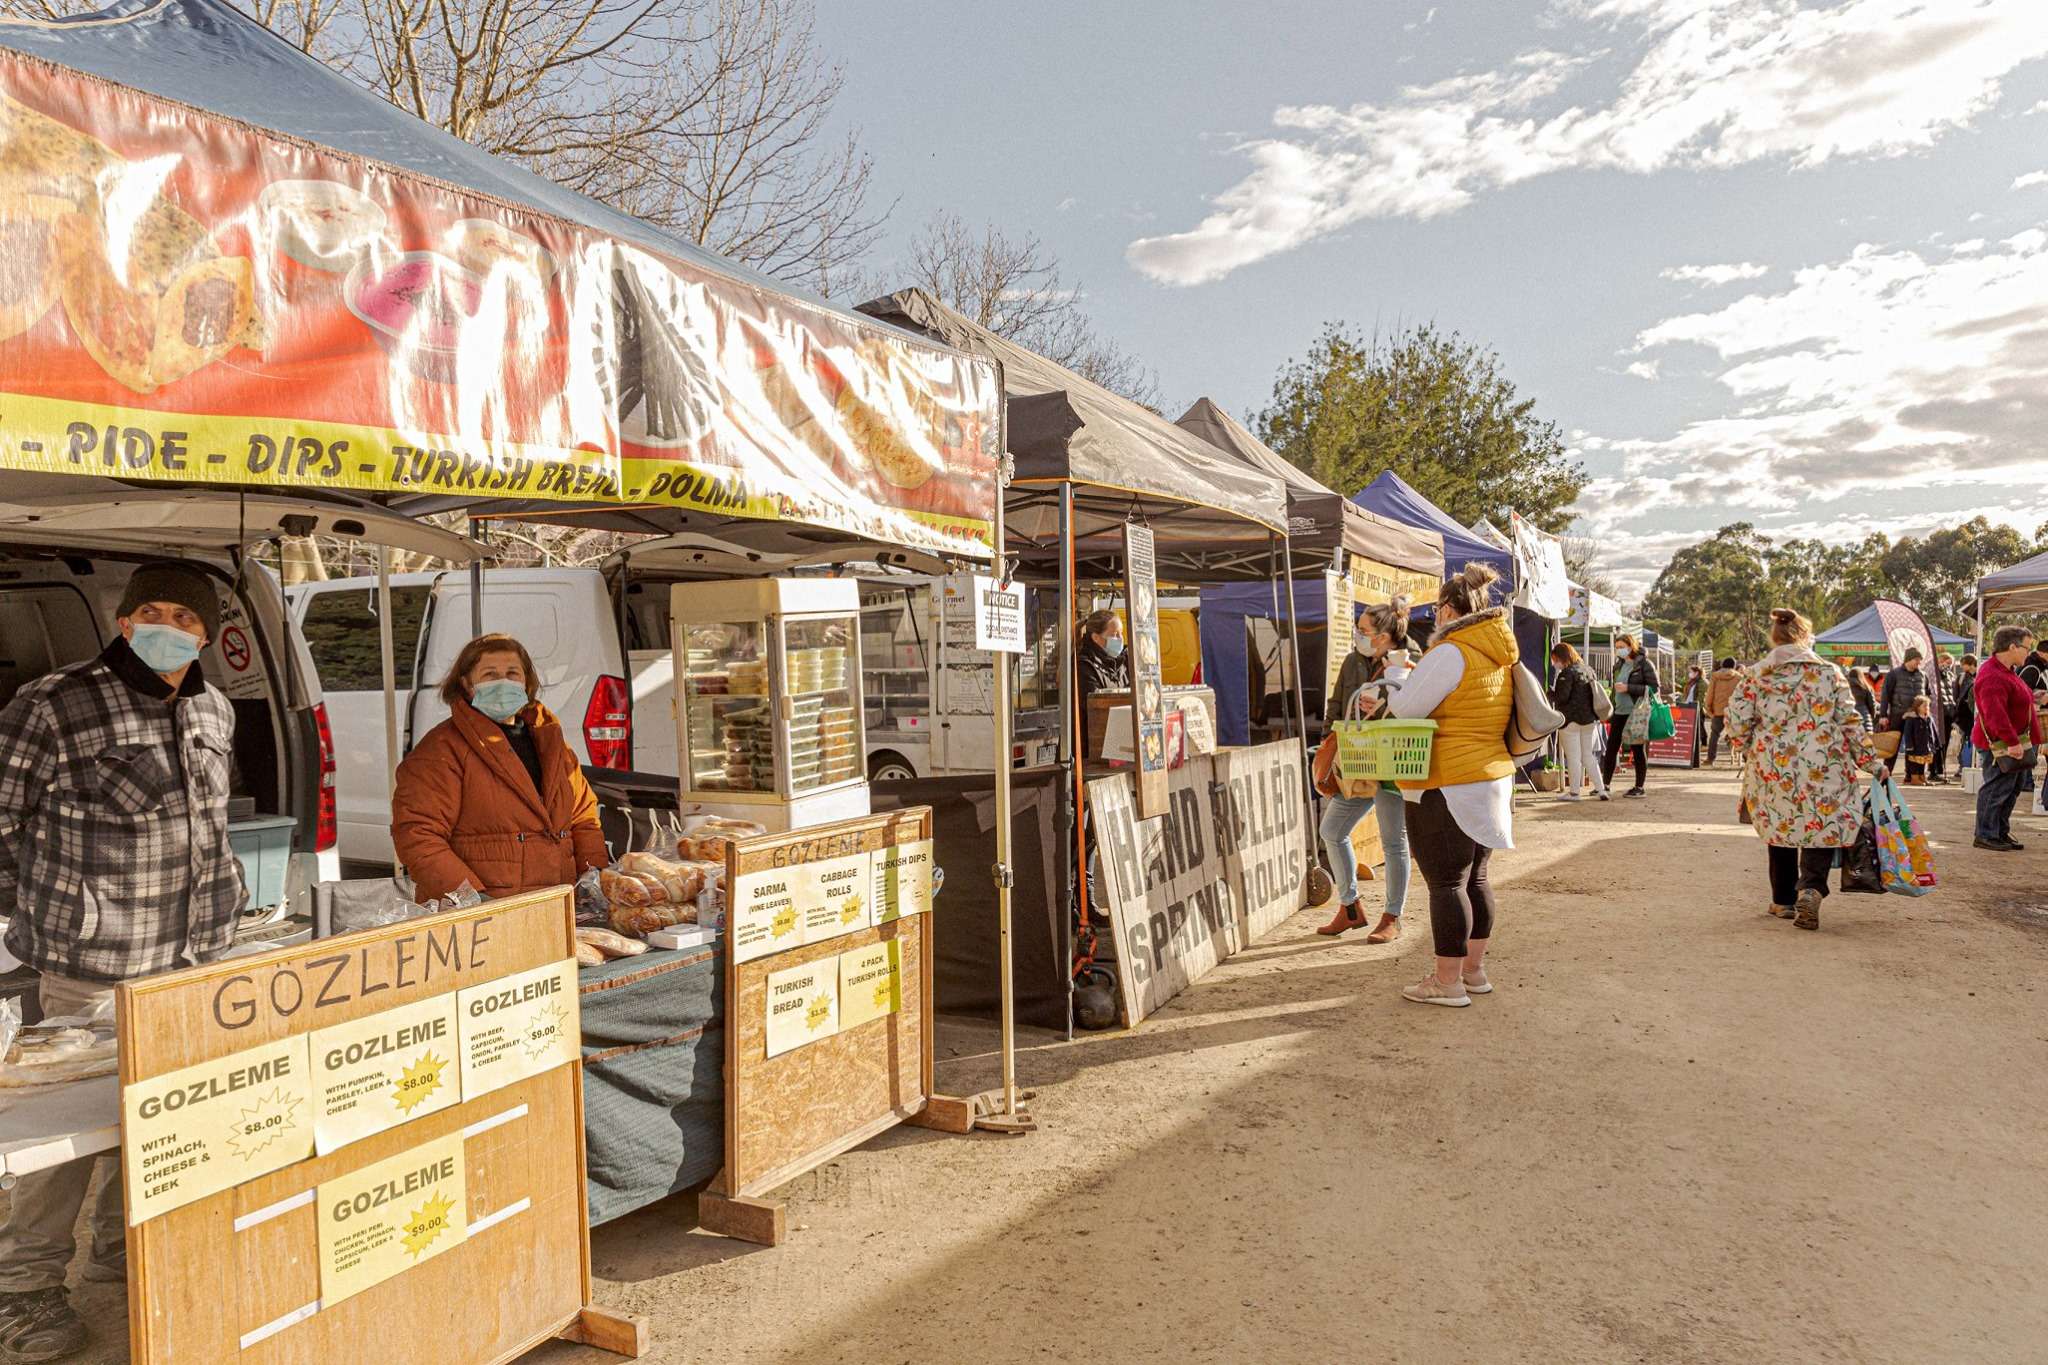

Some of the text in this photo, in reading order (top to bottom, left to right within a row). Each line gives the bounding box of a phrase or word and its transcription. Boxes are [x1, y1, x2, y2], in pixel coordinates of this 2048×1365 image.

[66, 421, 189, 470] PIDE
[247, 434, 349, 477] DIPS
[391, 446, 533, 490] TURKISH
[537, 461, 619, 497] BREAD
[649, 472, 747, 509] DOLMA
[988, 592, 1016, 608] NOTICE
[1208, 760, 1297, 858] ROLLED
[876, 853, 927, 871] TURKISH DIPS
[821, 868, 857, 883] CABBAGE
[1240, 848, 1300, 917] ROLLS
[753, 882, 787, 898] SARMA
[827, 885, 851, 898] ROLLS
[867, 955, 883, 966] PACK
[848, 964, 897, 986] TURKISH ROLLS
[774, 976, 814, 996] TURKISH
[470, 976, 561, 1017] GOZLEME
[773, 998, 803, 1015] BREAD
[471, 1032, 487, 1041] WITH
[531, 1025, 555, 1040] $9.00
[325, 1017, 447, 1071] GOZLEME
[495, 1038, 520, 1052] PARSLEY
[478, 1054, 502, 1067] CHEESE
[139, 1056, 291, 1119] GOZLEME
[326, 1083, 346, 1095] WITH
[365, 1081, 384, 1092] LEEK
[403, 1073, 434, 1091] $8.00
[326, 1100, 357, 1115] CHEESE
[244, 1115, 282, 1135] $8.00
[142, 1133, 177, 1152] WITH
[143, 1139, 206, 1168] SPINACH,
[144, 1153, 210, 1183] CHEESE &
[144, 1179, 179, 1199] LEEK
[333, 1157, 454, 1222] GOZLEME
[412, 1216, 441, 1237] $9.00
[334, 1235, 351, 1247] WITH
[336, 1257, 361, 1272] CHEESE
